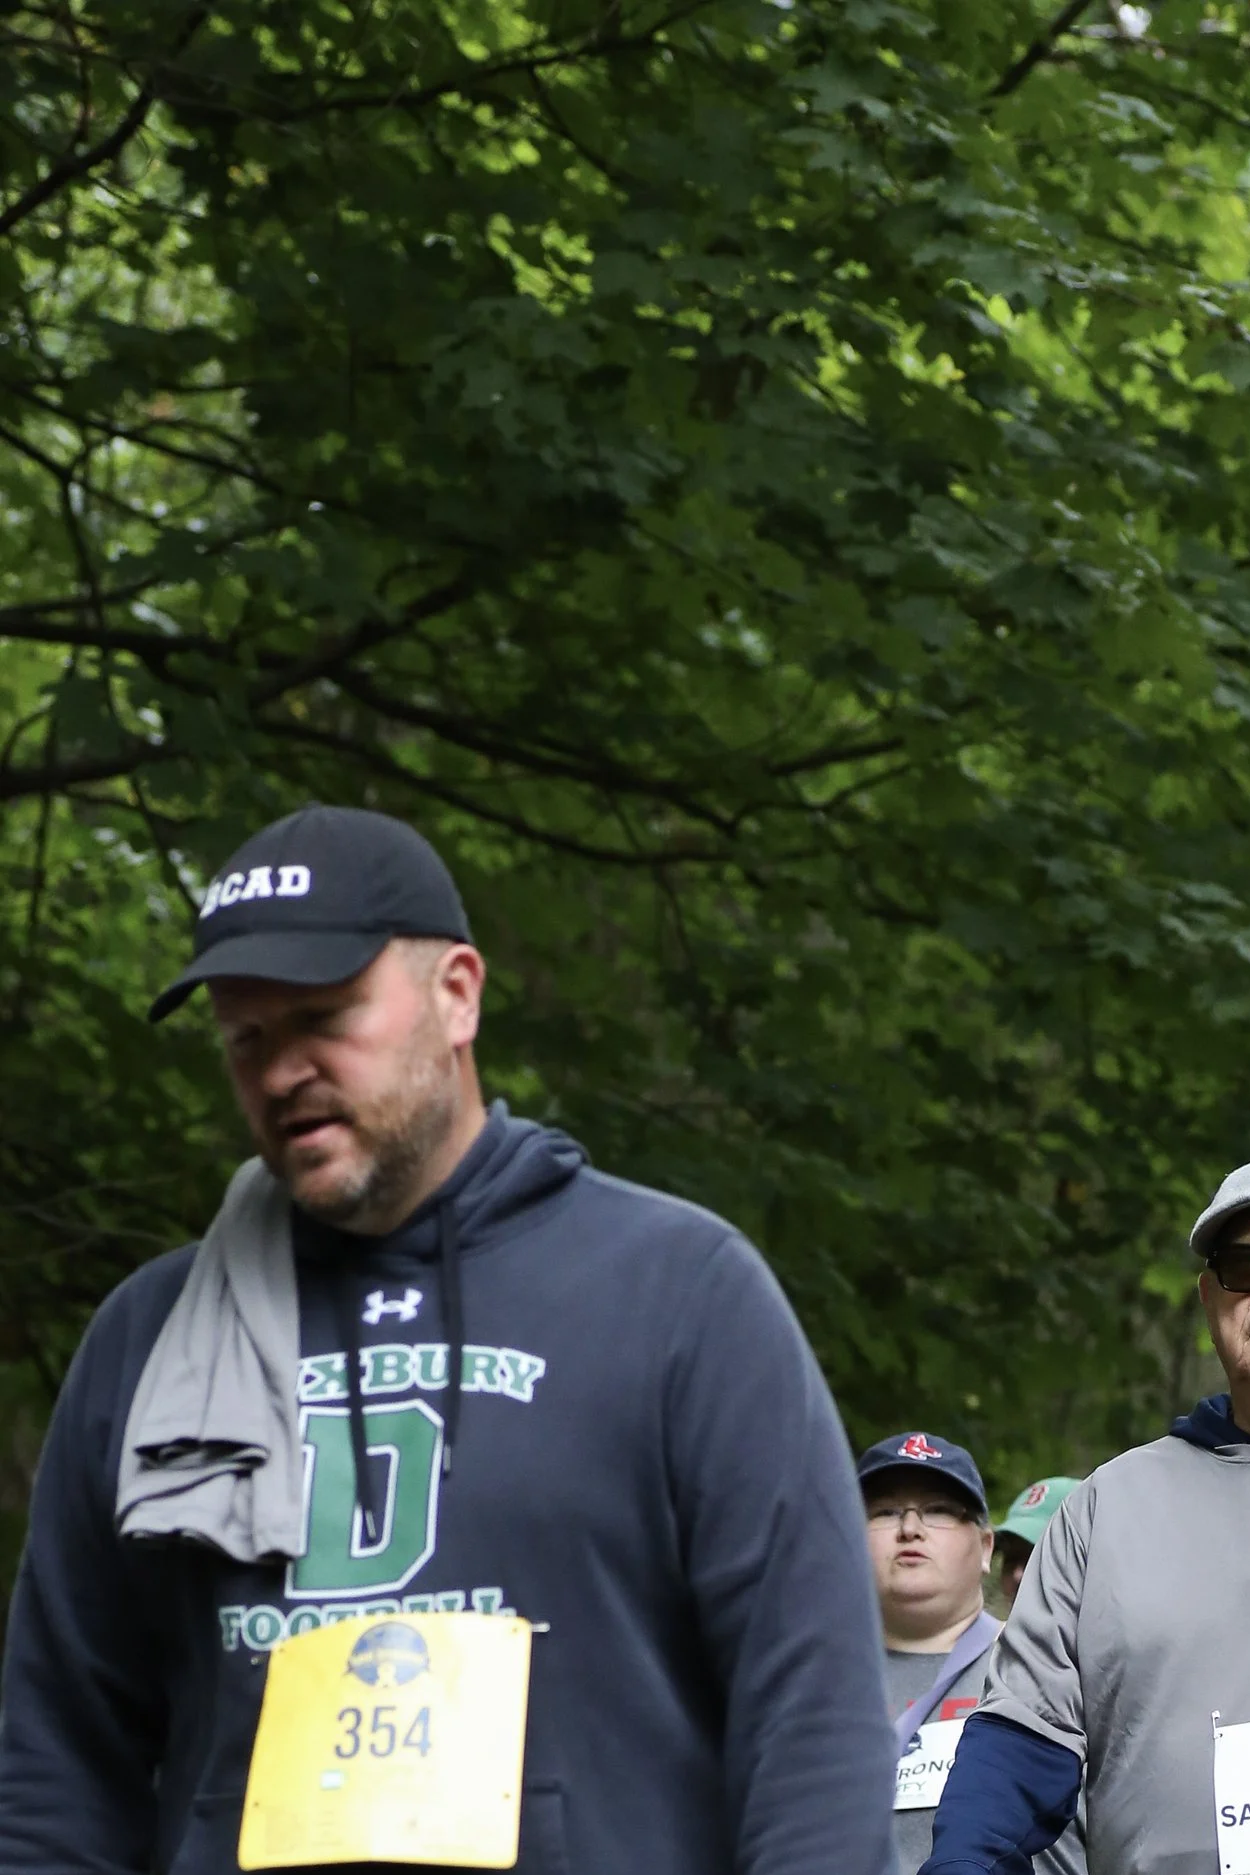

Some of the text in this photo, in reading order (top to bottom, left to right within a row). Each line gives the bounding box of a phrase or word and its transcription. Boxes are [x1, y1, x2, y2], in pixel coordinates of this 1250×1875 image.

[199, 865, 311, 919] CAD
[297, 1343, 547, 1402] XBURY
[286, 1399, 444, 1598] D
[334, 1705, 433, 1759] 354
